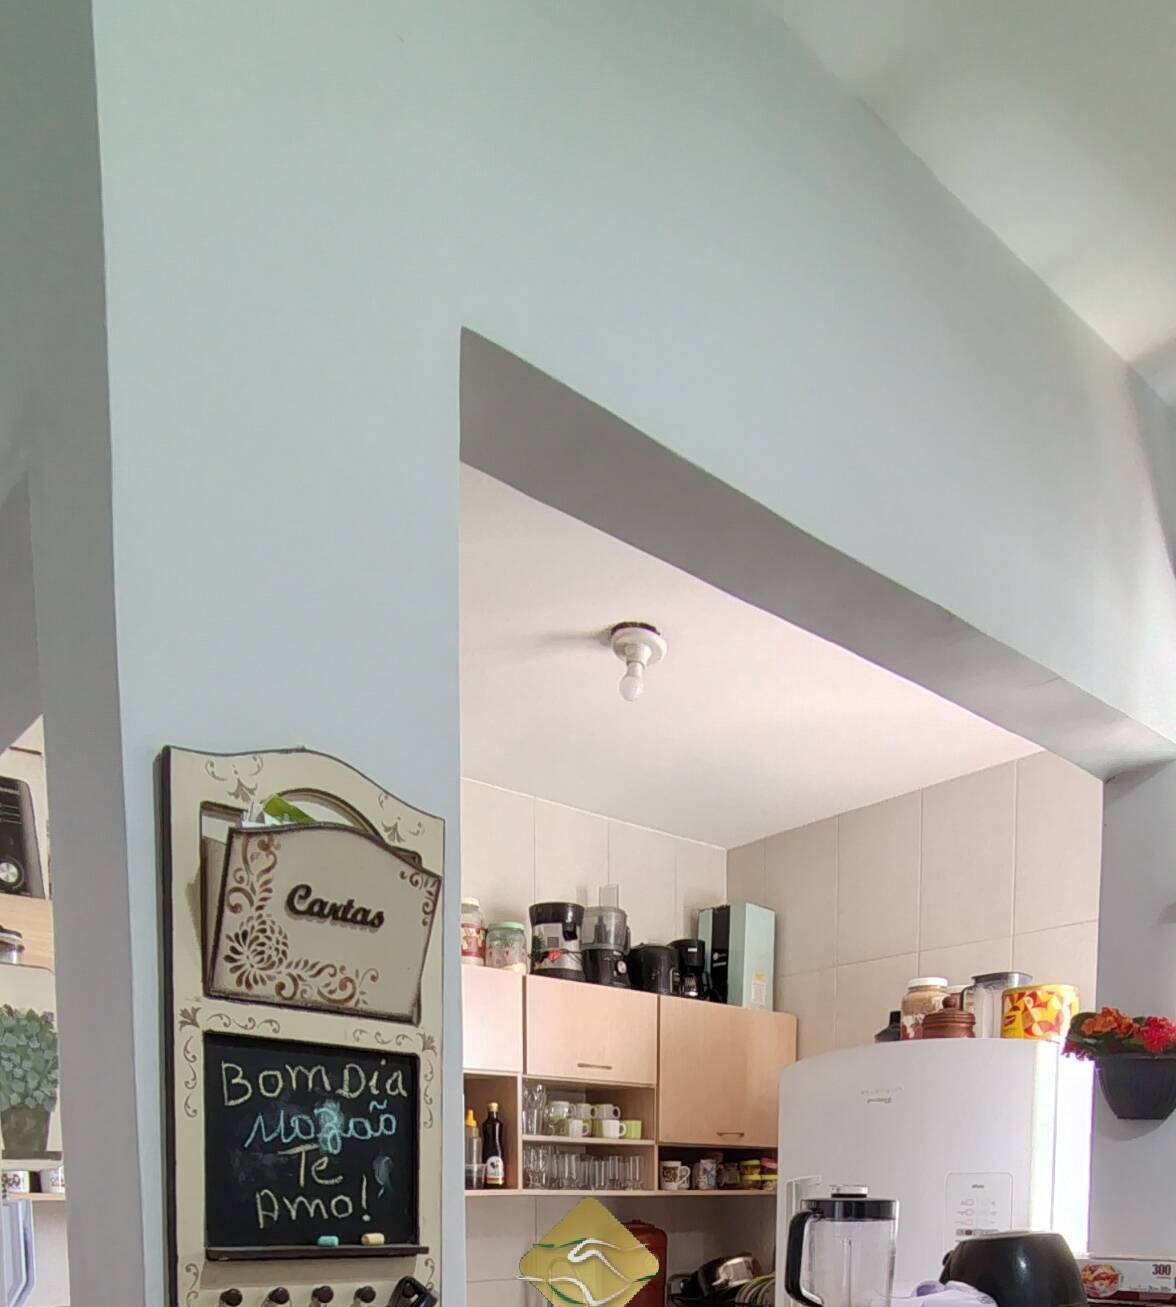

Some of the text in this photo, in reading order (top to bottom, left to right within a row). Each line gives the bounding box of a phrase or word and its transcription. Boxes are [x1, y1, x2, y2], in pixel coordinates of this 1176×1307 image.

[286, 884, 385, 929] Cartas
[335, 1058, 408, 1099] Dia
[278, 1142, 344, 1188] Te
[256, 1173, 371, 1229] Amo!
[1152, 1263, 1172, 1276] 300
